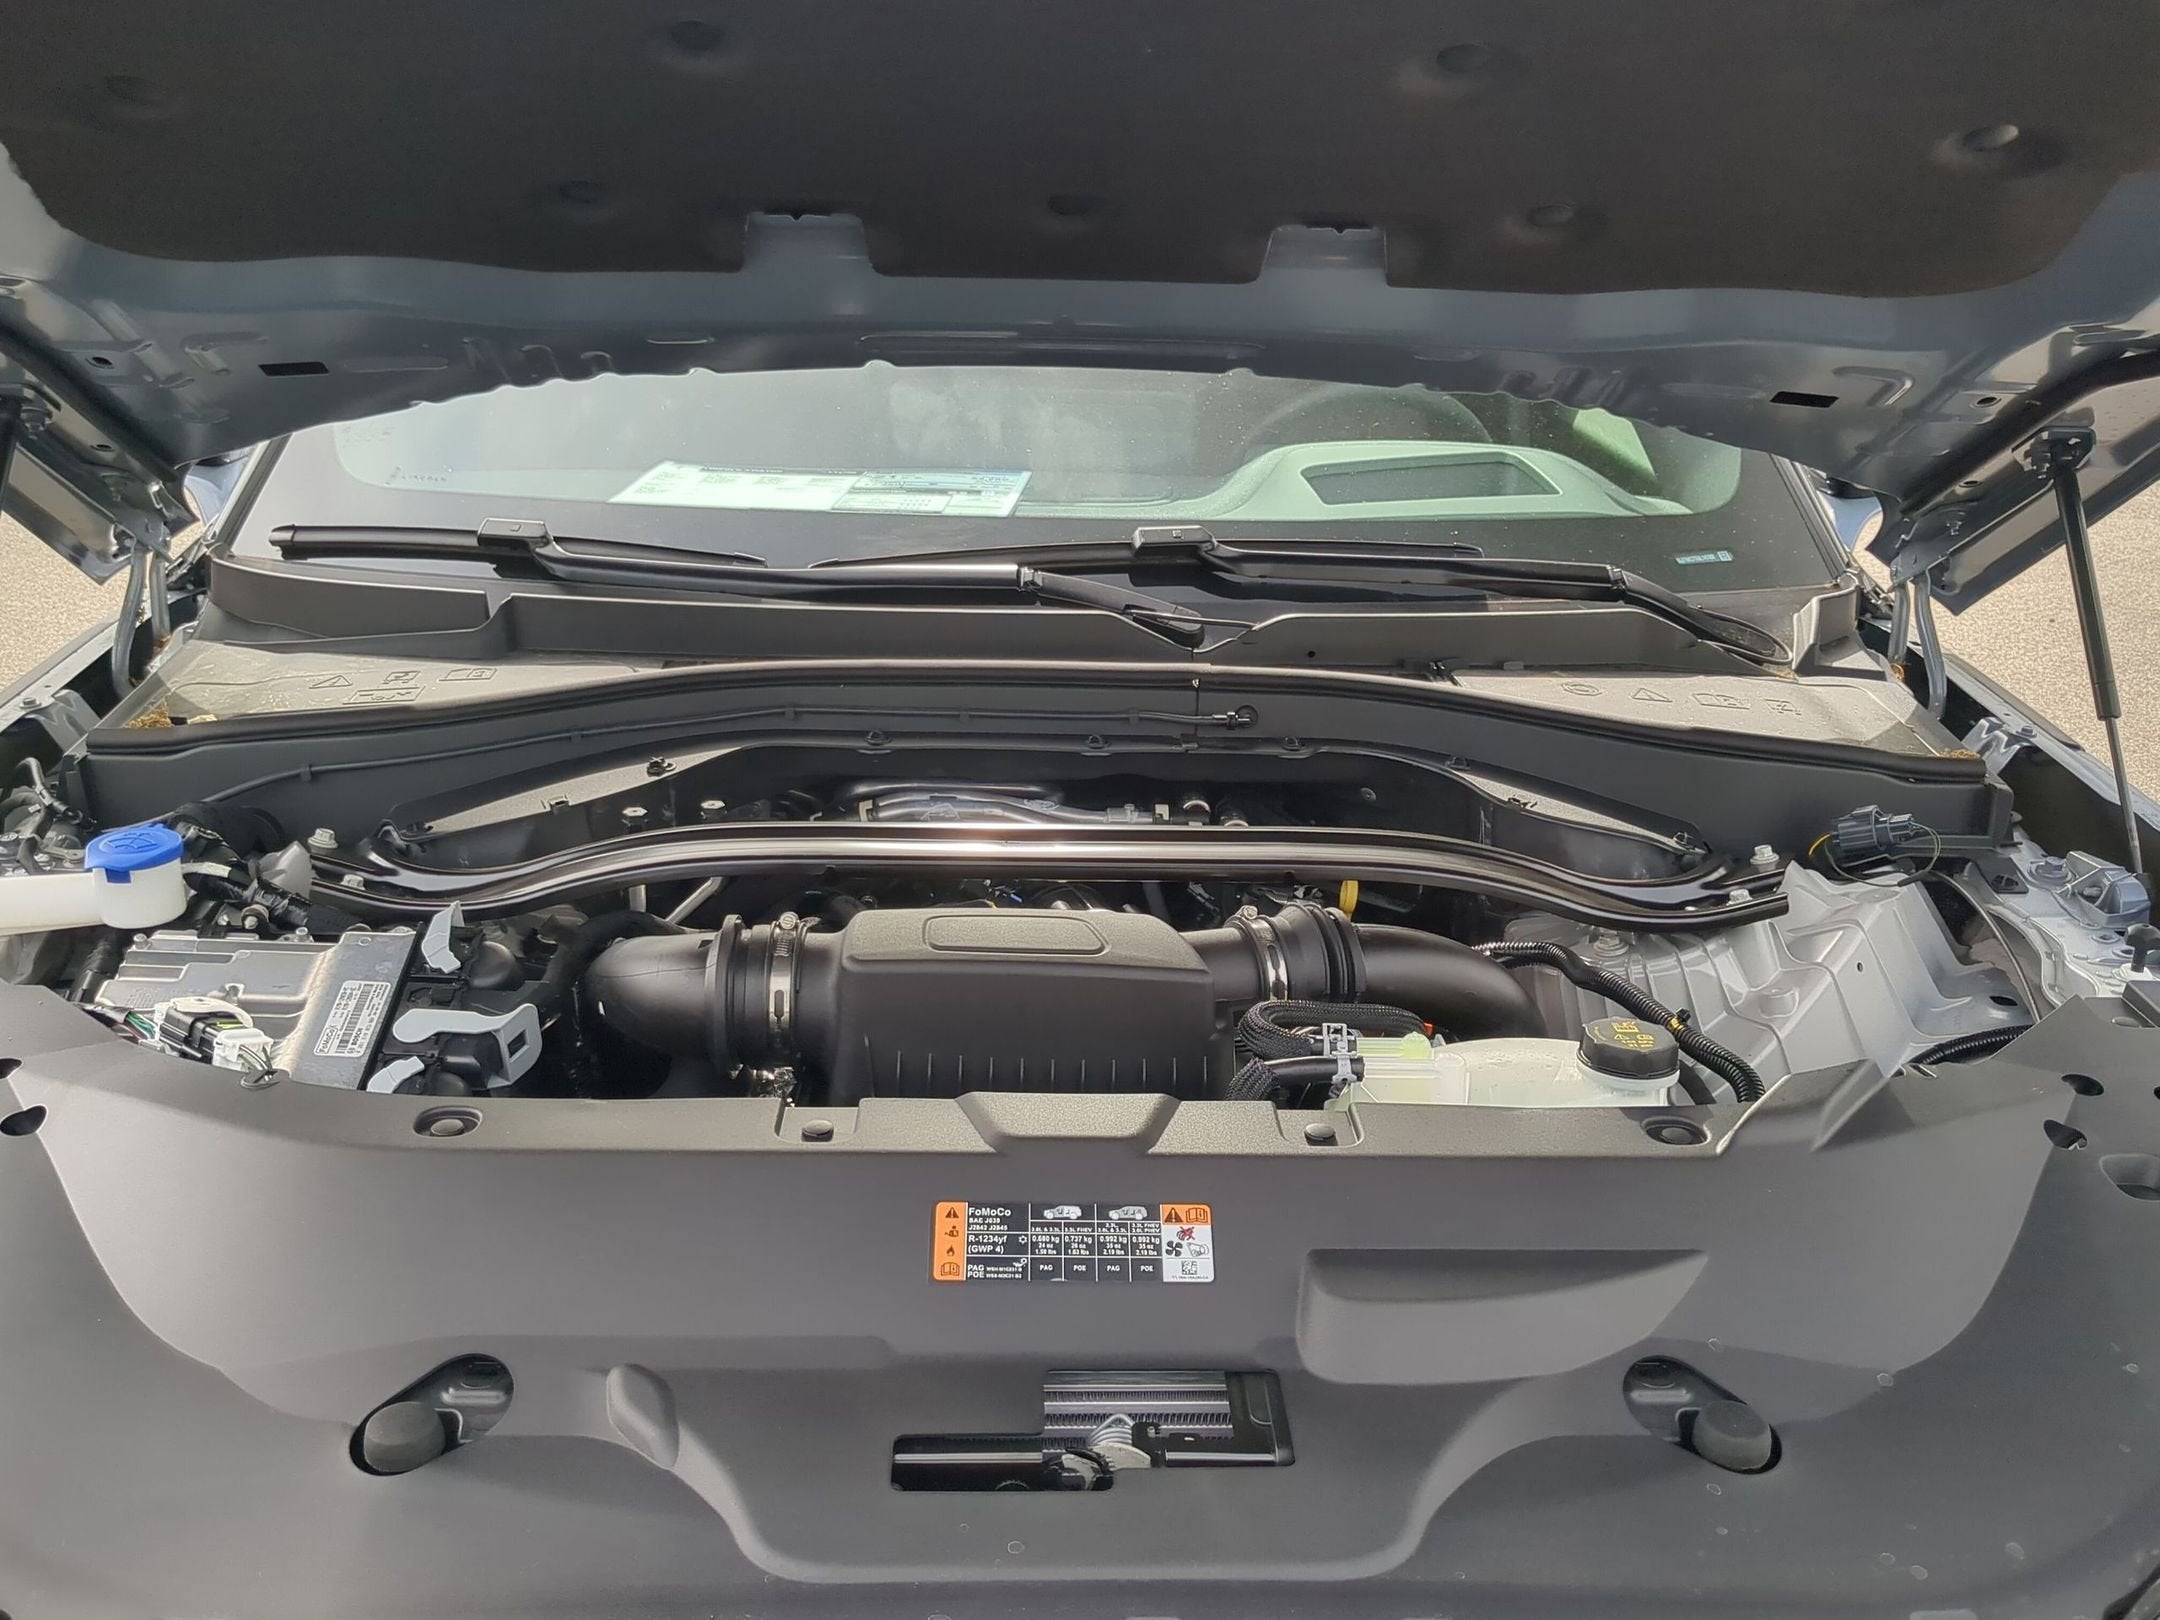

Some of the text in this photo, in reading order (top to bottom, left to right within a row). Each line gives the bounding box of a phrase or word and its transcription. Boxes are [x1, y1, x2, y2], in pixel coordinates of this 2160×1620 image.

[350, 1027, 364, 1046] BOSCH
[968, 1207, 1012, 1217] FoMoCo
[968, 1234, 1007, 1244] R-1234yf
[1051, 1235, 1060, 1244] kg
[1083, 1235, 1093, 1244] kg
[1118, 1235, 1128, 1244] kg
[1151, 1236, 1160, 1245] kg
[968, 1245, 1004, 1254] (GWP 4)
[1106, 1264, 1120, 1272] PAG
